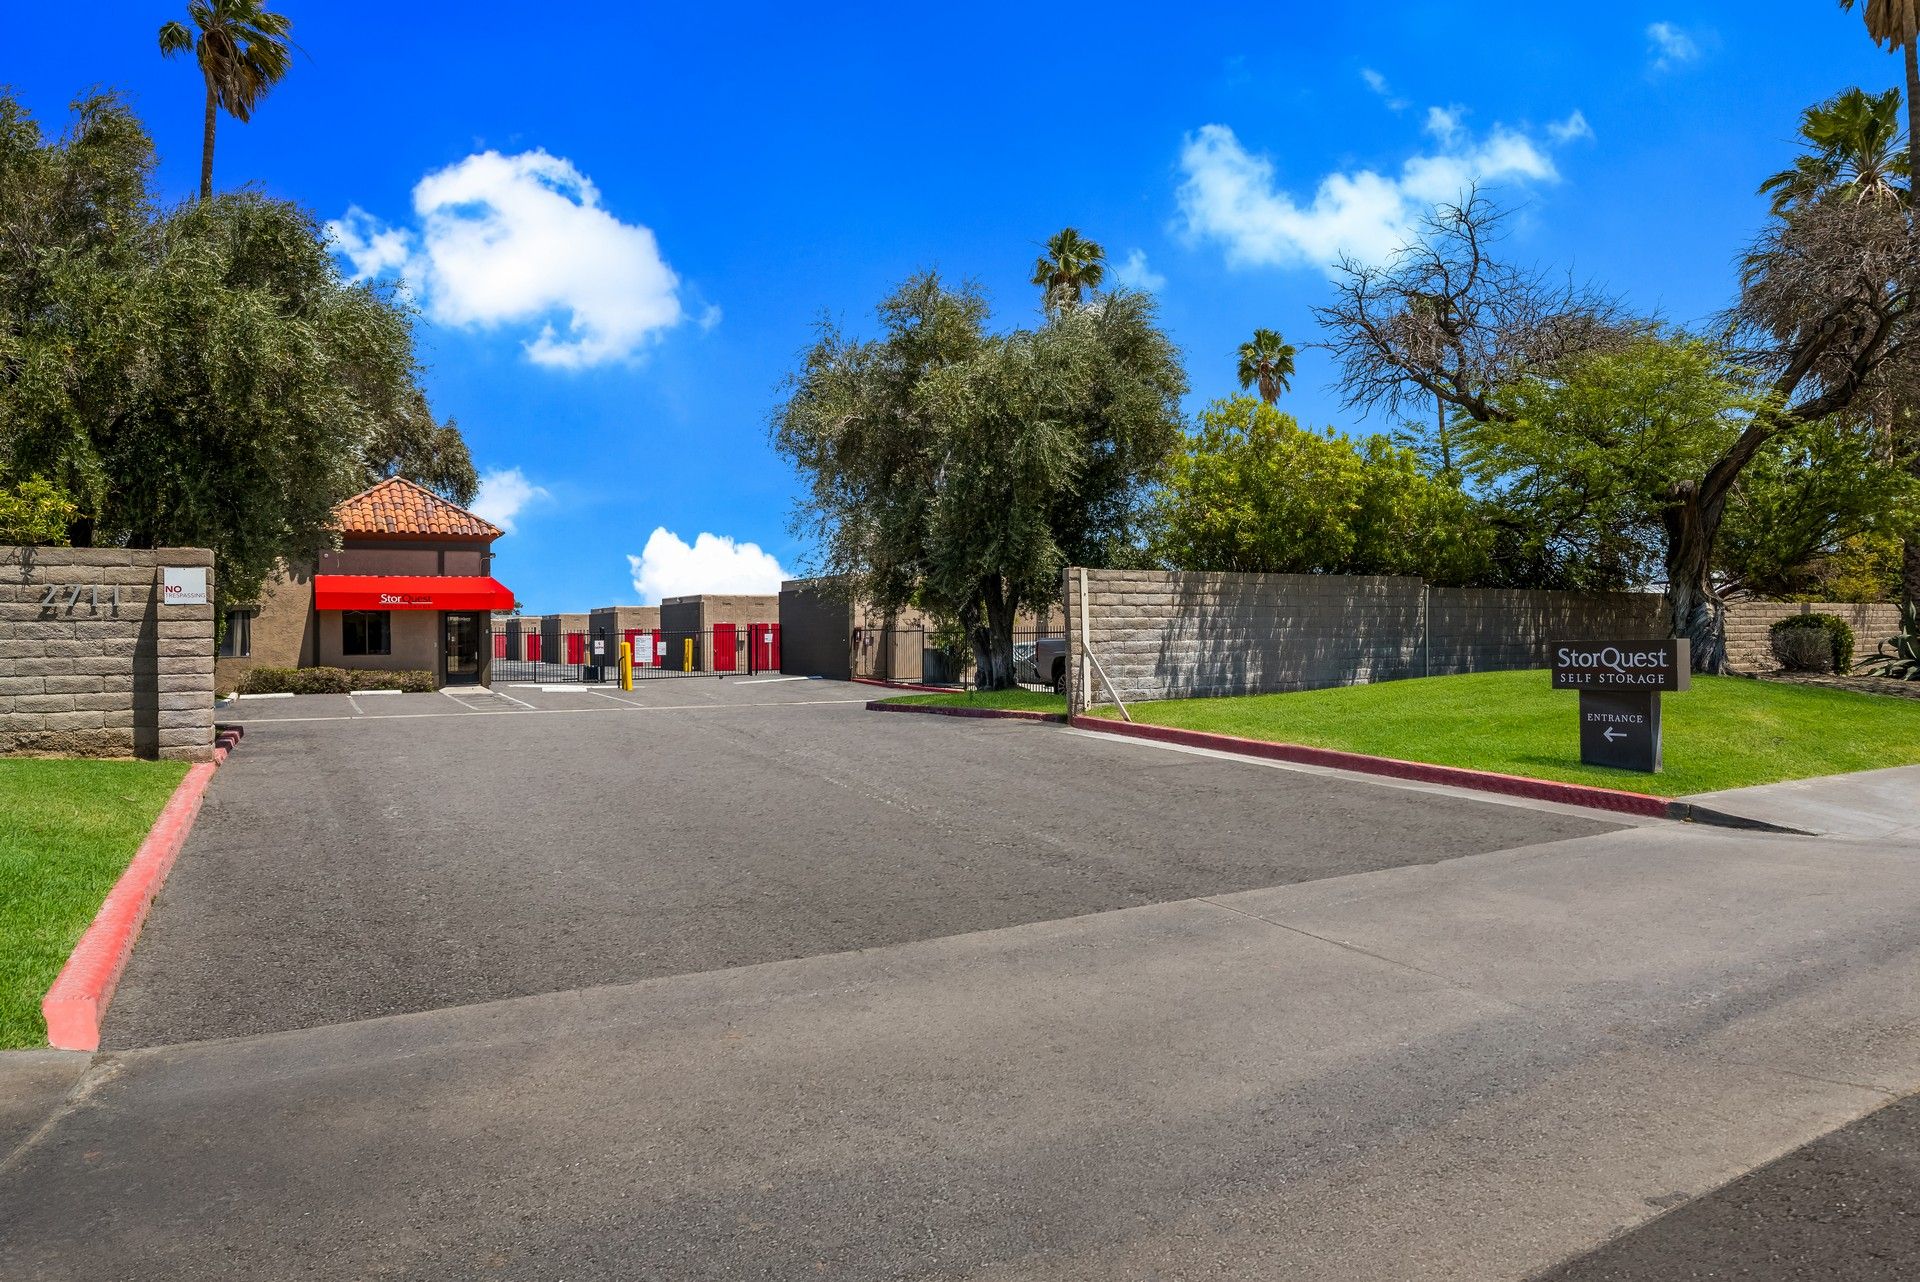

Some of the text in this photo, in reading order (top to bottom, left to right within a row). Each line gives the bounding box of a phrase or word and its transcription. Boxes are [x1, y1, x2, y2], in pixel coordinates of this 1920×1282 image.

[165, 585, 182, 593] NO
[41, 583, 120, 608] 2711
[1558, 647, 1668, 673] StorQuest
[1560, 673, 1665, 684] SELF STORAGE
[1587, 713, 1643, 723] ENTRANCE
